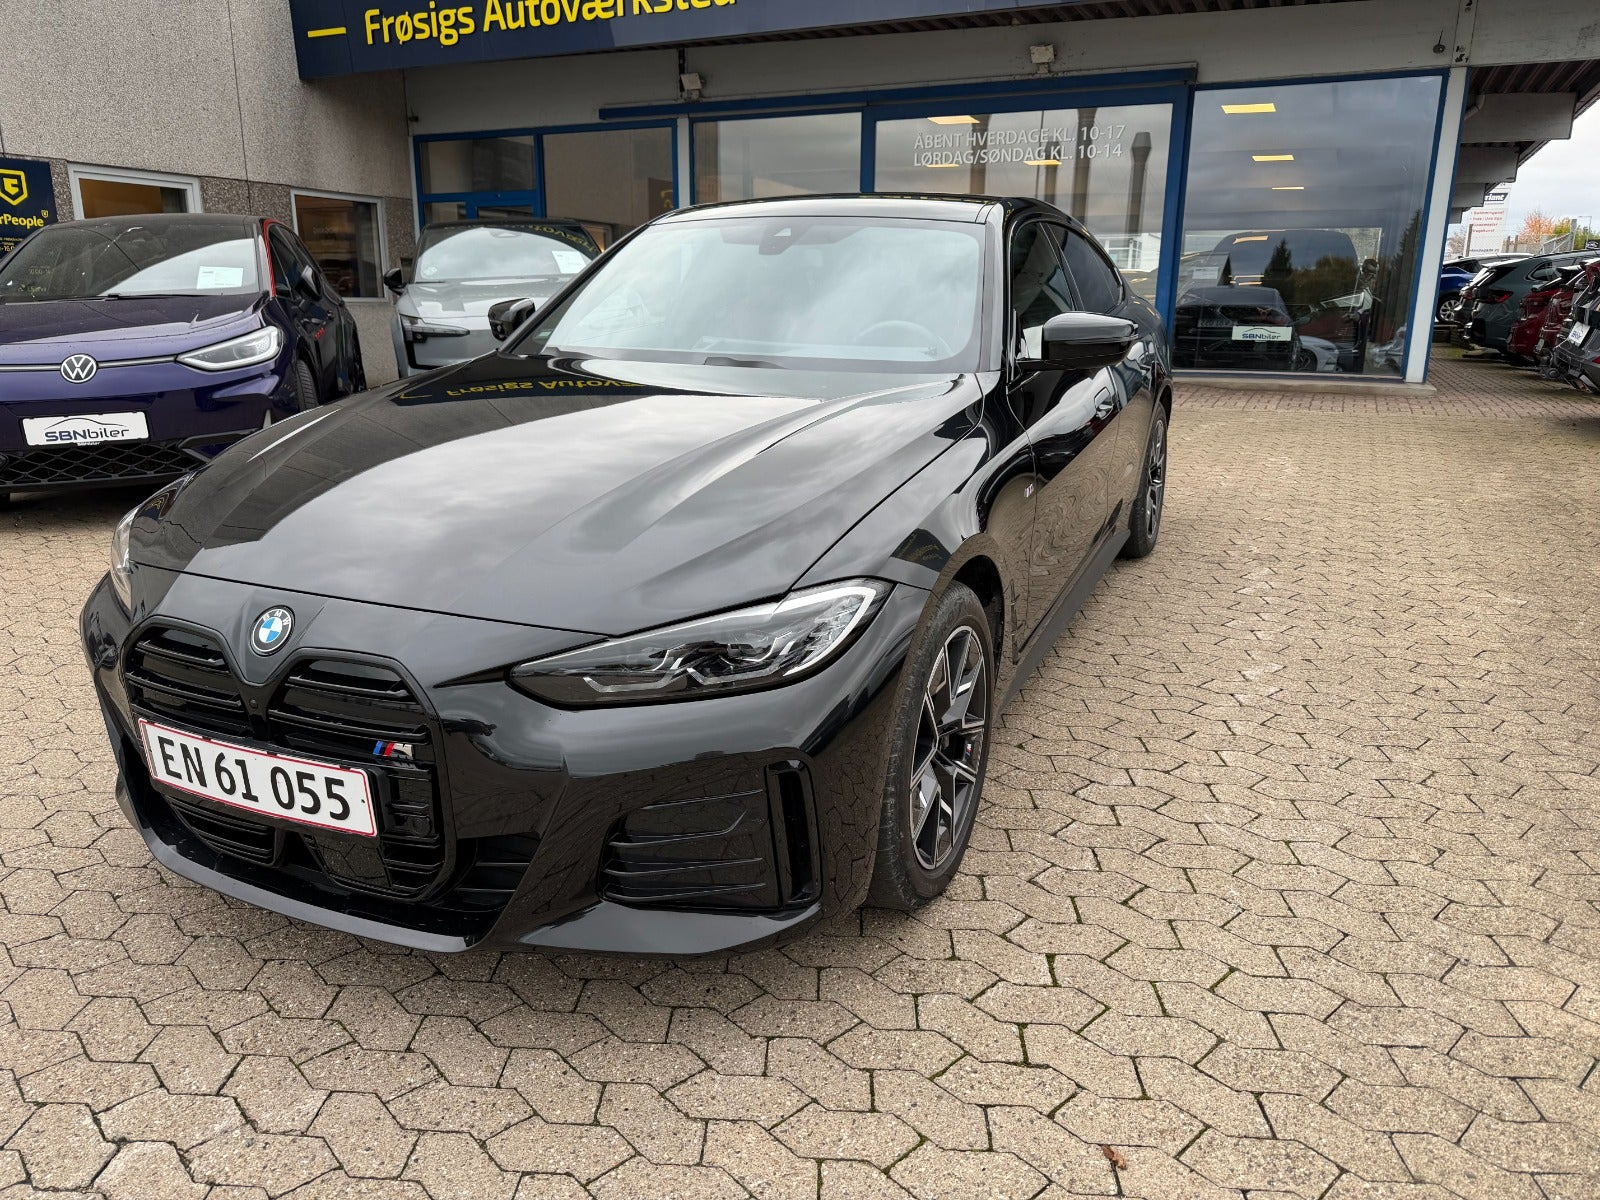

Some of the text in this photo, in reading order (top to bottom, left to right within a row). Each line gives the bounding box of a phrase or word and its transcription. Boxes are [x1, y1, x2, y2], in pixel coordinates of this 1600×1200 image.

[364, 0, 737, 46] Frøsigs Autoværks
[914, 124, 1127, 150] ÅBENT HVERDAGE KL. 10-17
[914, 143, 1123, 167] LØRDAG/SØNDAG KL. 10-14
[1242, 332, 1281, 341] SBNbiler
[45, 427, 129, 442] SBNbiler
[262, 609, 291, 626] BMW
[158, 735, 351, 821] EN 61 055
